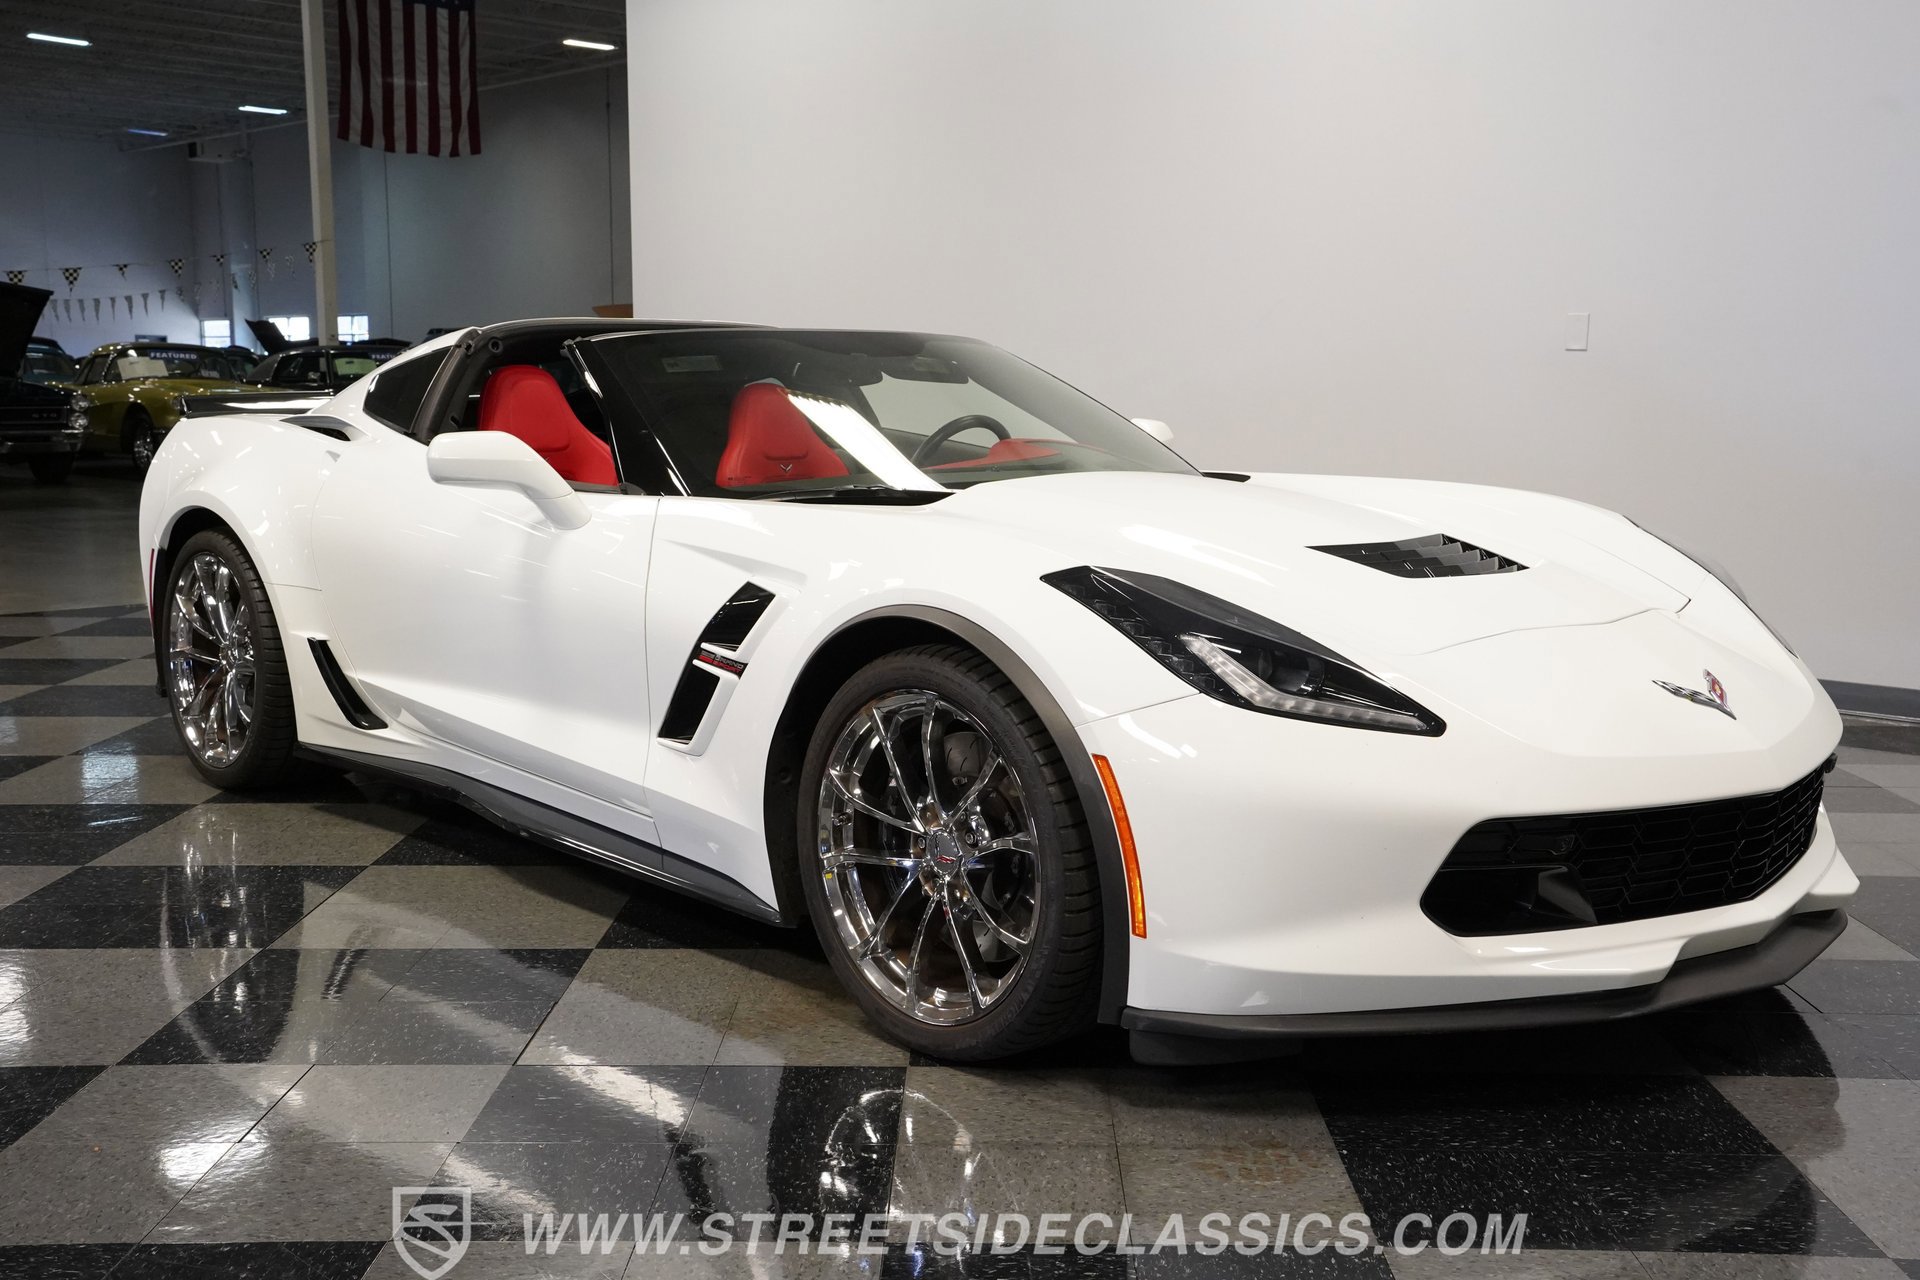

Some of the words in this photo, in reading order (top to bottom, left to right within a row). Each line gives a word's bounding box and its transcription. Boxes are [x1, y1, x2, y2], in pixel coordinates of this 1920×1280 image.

[150, 351, 198, 360] FEATURED
[712, 660, 743, 673] SPORT
[714, 654, 745, 669] GRAND
